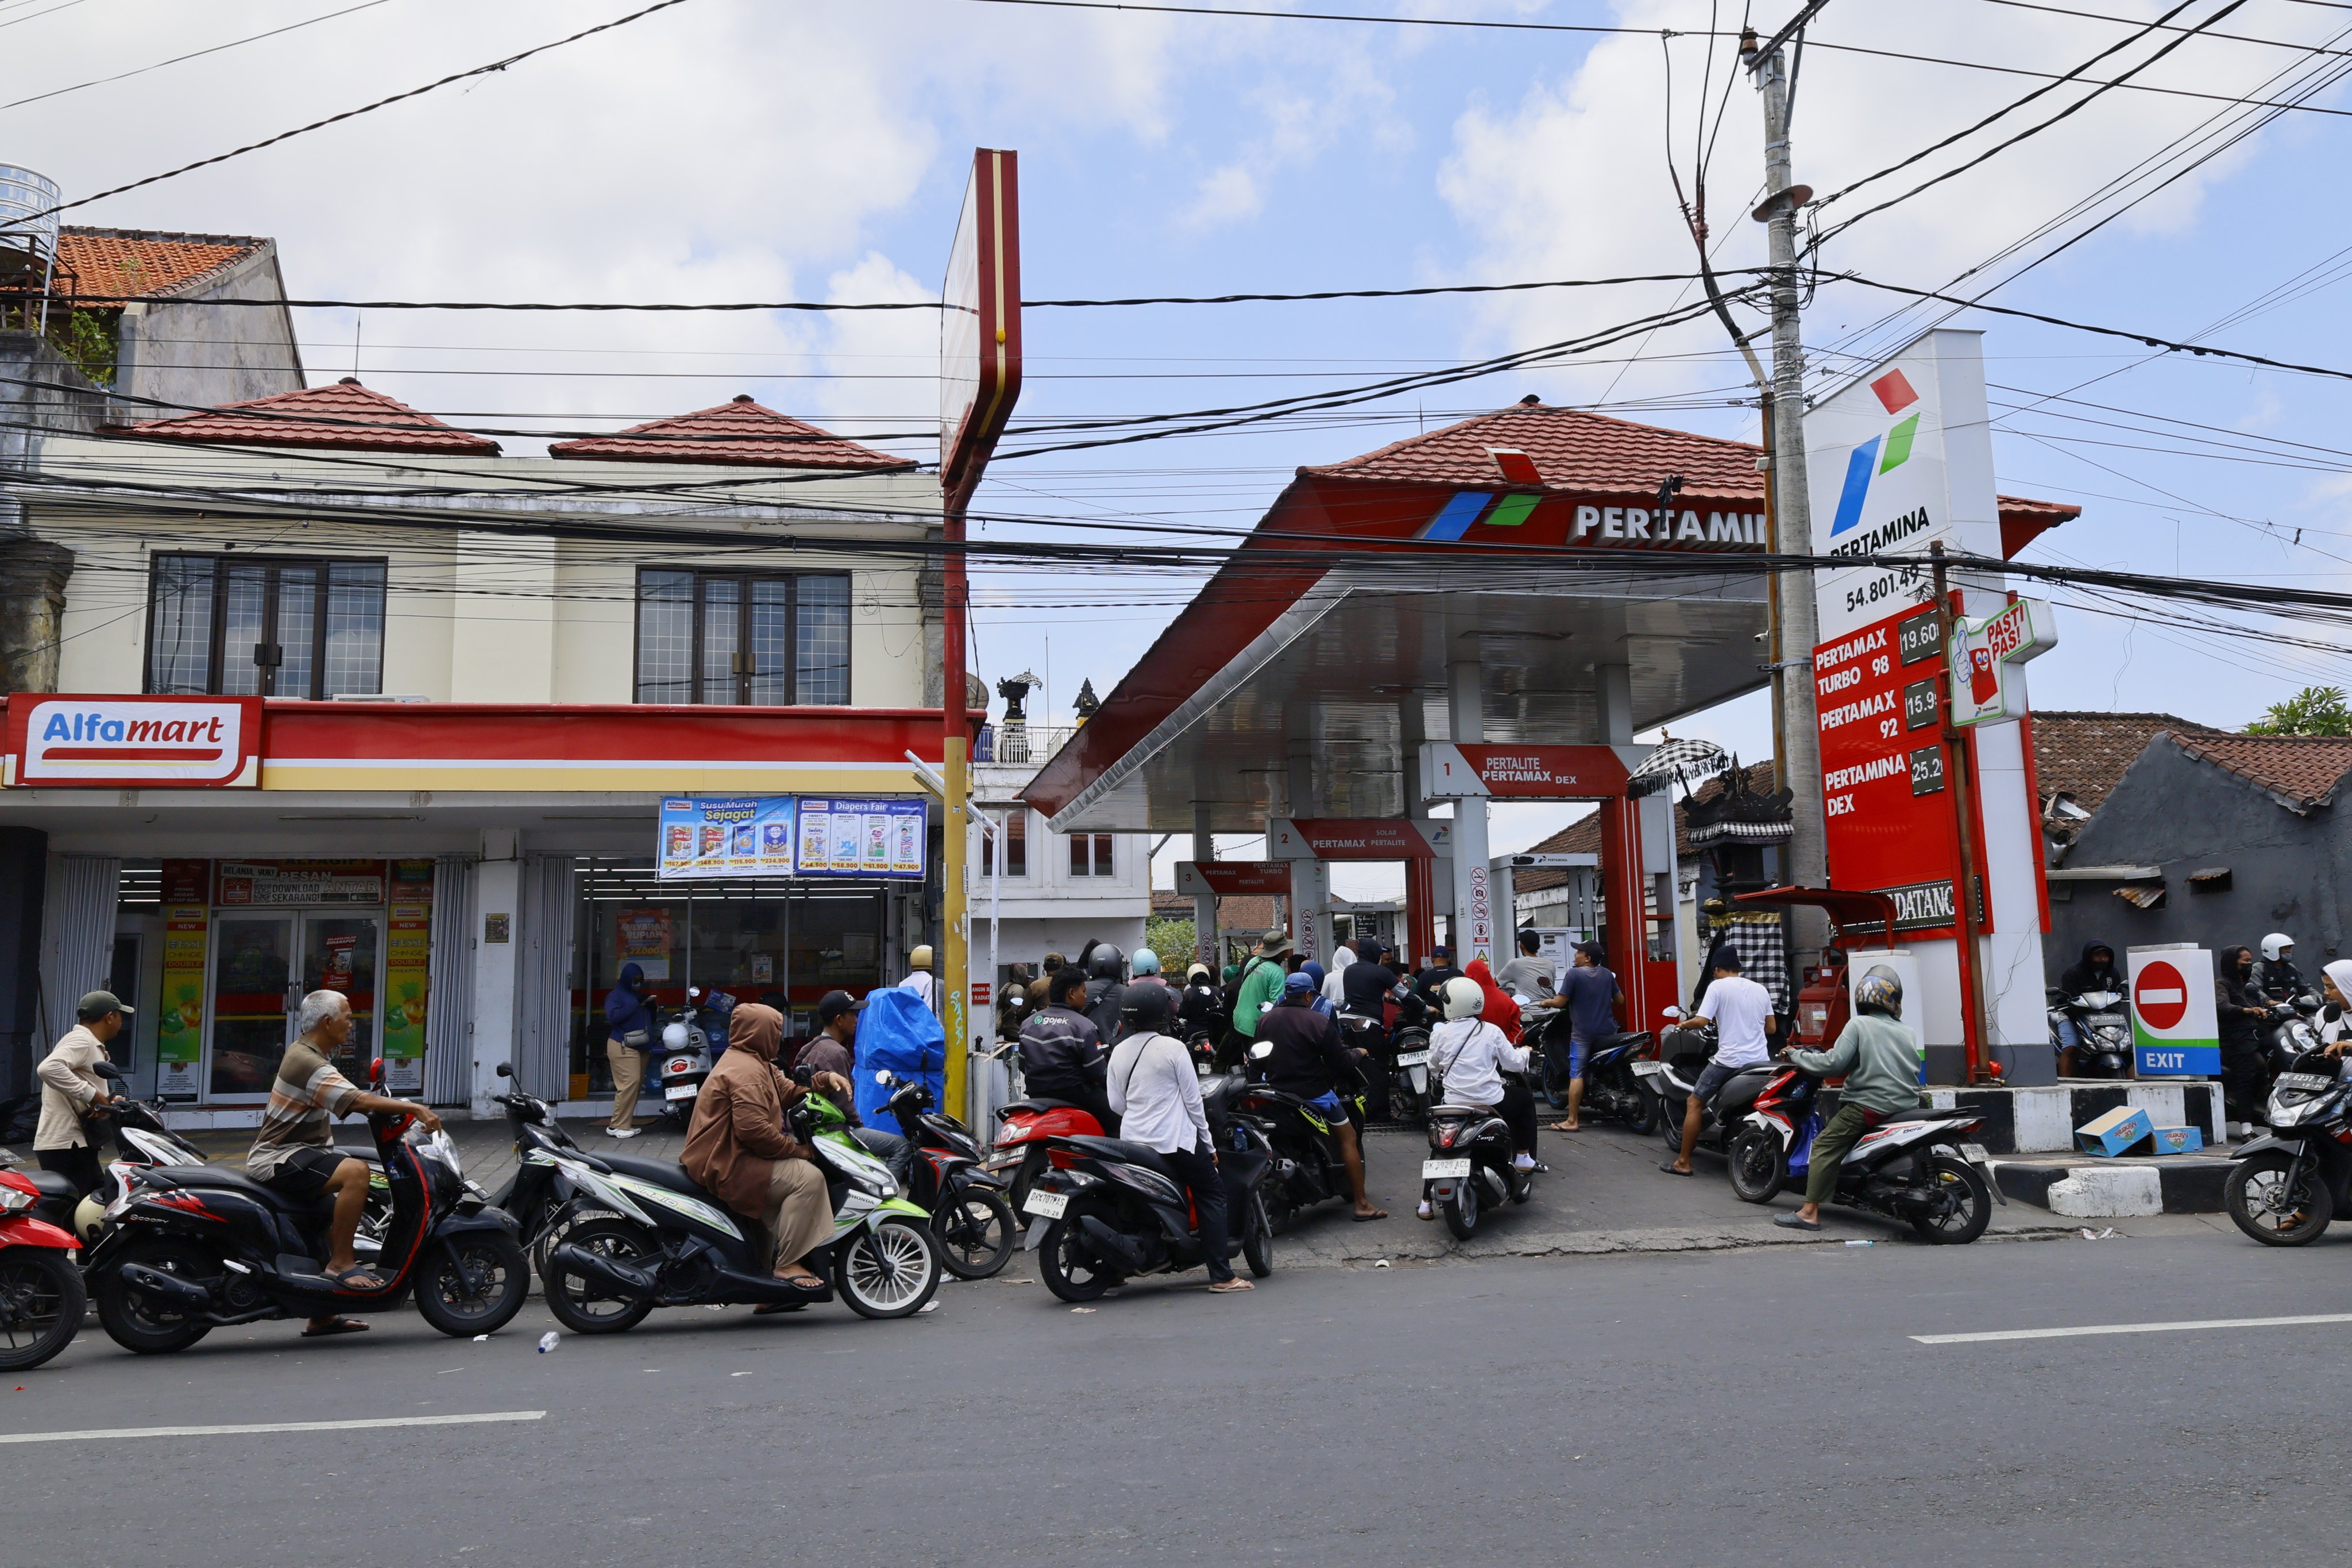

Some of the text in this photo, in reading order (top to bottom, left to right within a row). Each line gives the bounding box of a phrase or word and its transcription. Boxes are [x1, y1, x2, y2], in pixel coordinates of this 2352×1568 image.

[1987, 603, 2024, 645] PASTI
[1816, 627, 1888, 671] PERTAMAX
[1992, 626, 2021, 662] PAS!
[1818, 655, 1890, 696] TURBO 98
[1907, 691, 1937, 715] 15.9
[1821, 689, 1897, 731] PERTAMAX
[43, 713, 224, 743] Alfamart
[1880, 718, 1898, 739] 92
[1444, 763, 1450, 776] 1
[1486, 757, 1540, 770] PERTALITE
[1912, 758, 1943, 782] 25.2
[1481, 770, 1577, 785] PERTAMAX DEX
[1825, 753, 1907, 791] PERTAMINA
[836, 802, 888, 812] Diapers Fair
[1828, 793, 1856, 817] DEX
[705, 809, 756, 822] Sejagat
[1280, 833, 1288, 844] 2
[1312, 839, 1366, 848] PERTAMAX
[223, 866, 275, 877] BELANJA, YUK!
[279, 871, 332, 883] PESAN
[1185, 874, 1192, 882] 3
[272, 883, 320, 893] DOWNLOAD
[323, 880, 377, 893] ANTAR
[271, 893, 320, 903] SEKARANG!
[400, 939, 423, 947] ESSE
[1042, 1017, 1068, 1025] gojek
[1407, 1052, 1420, 1060] 3791
[2146, 1053, 2185, 1068] EXIT
[2114, 1121, 2137, 1137] Minerale
[2324, 1118, 2343, 1127] HONDA
[536, 1151, 556, 1160] HONDA
[1436, 1161, 1453, 1170] 3929
[1454, 1160, 1469, 1169] ACL
[634, 1184, 678, 1207] VARIO
[851, 1194, 874, 1204] HONDA
[1030, 1192, 1039, 1202] DK
